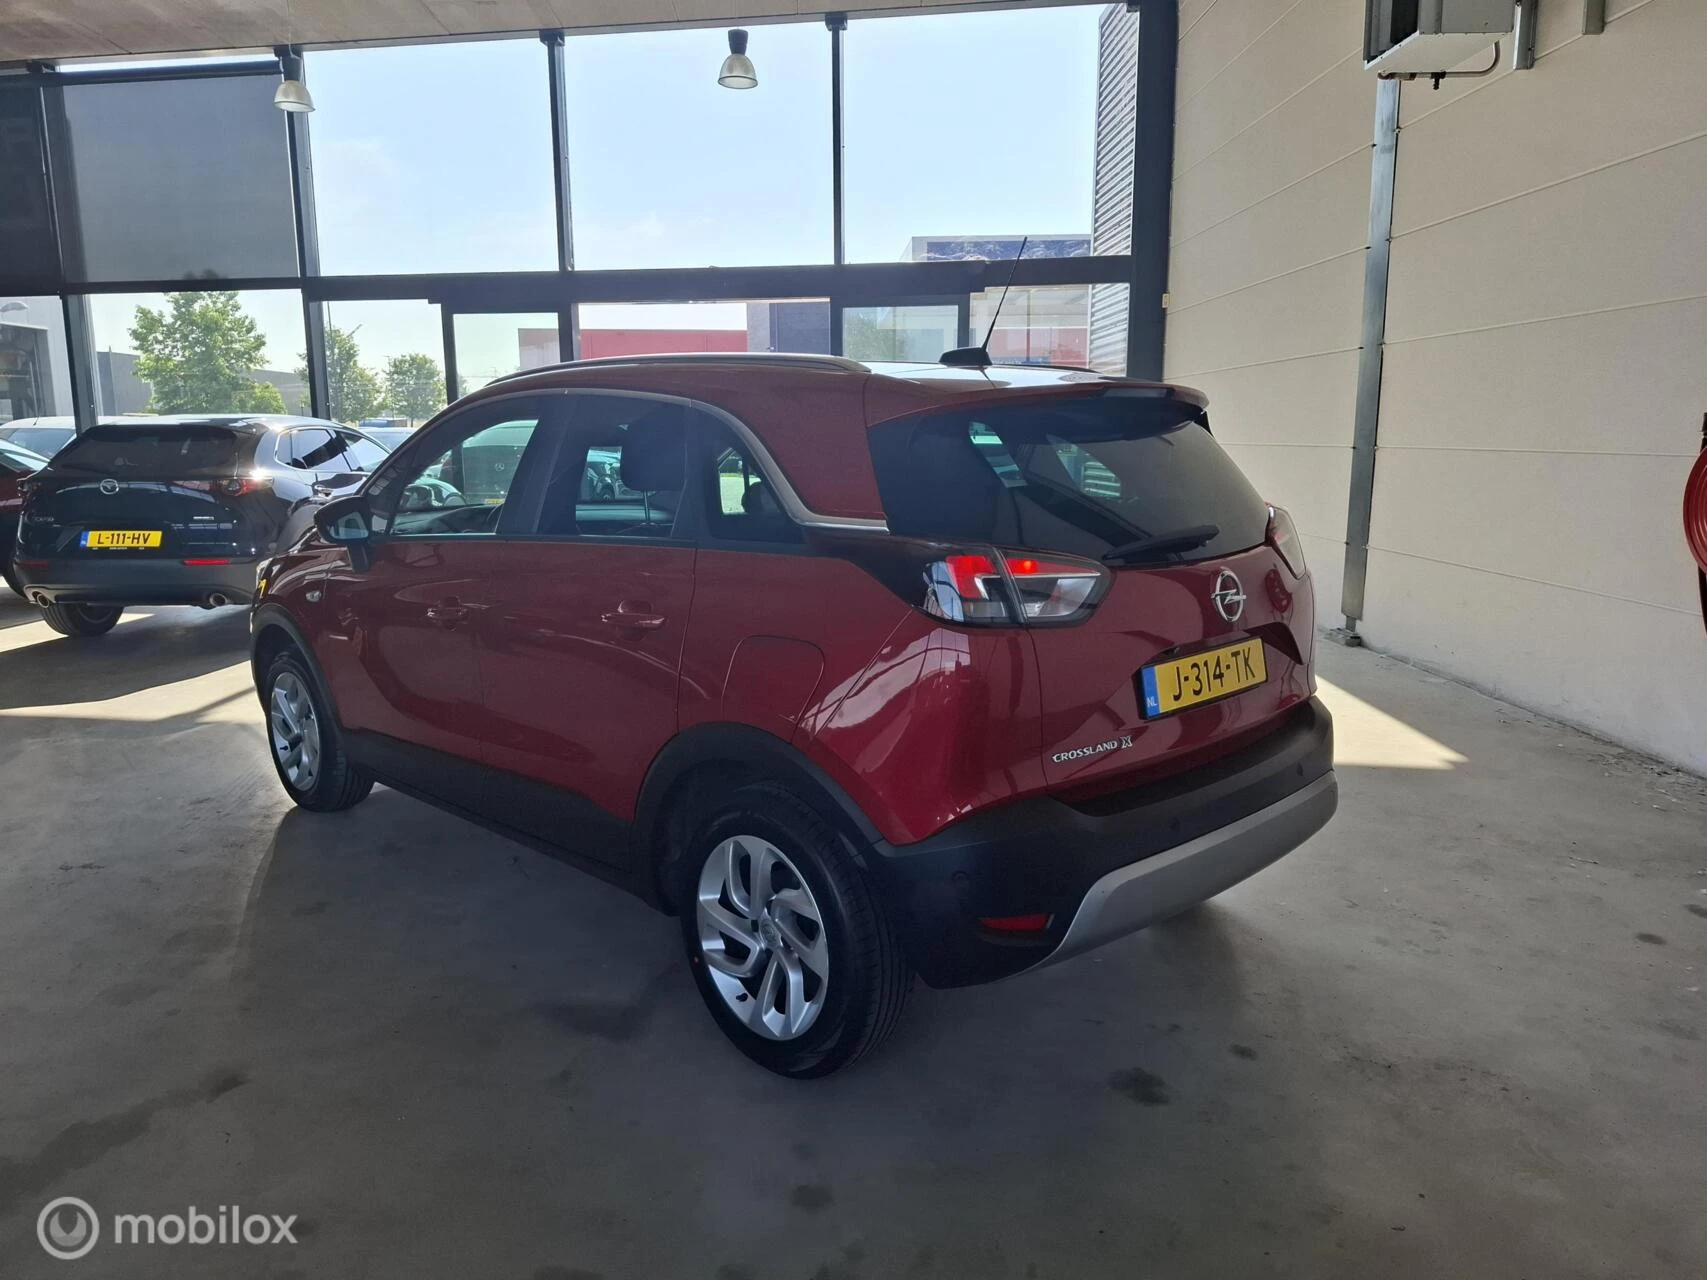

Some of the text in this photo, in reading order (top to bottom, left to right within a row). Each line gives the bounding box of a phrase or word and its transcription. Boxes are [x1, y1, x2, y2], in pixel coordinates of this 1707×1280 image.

[97, 532, 151, 545] L-111-HV
[1173, 647, 1256, 701] J-314-TK
[1146, 695, 1158, 708] NL
[1052, 735, 1133, 763] CROSSLAND X
